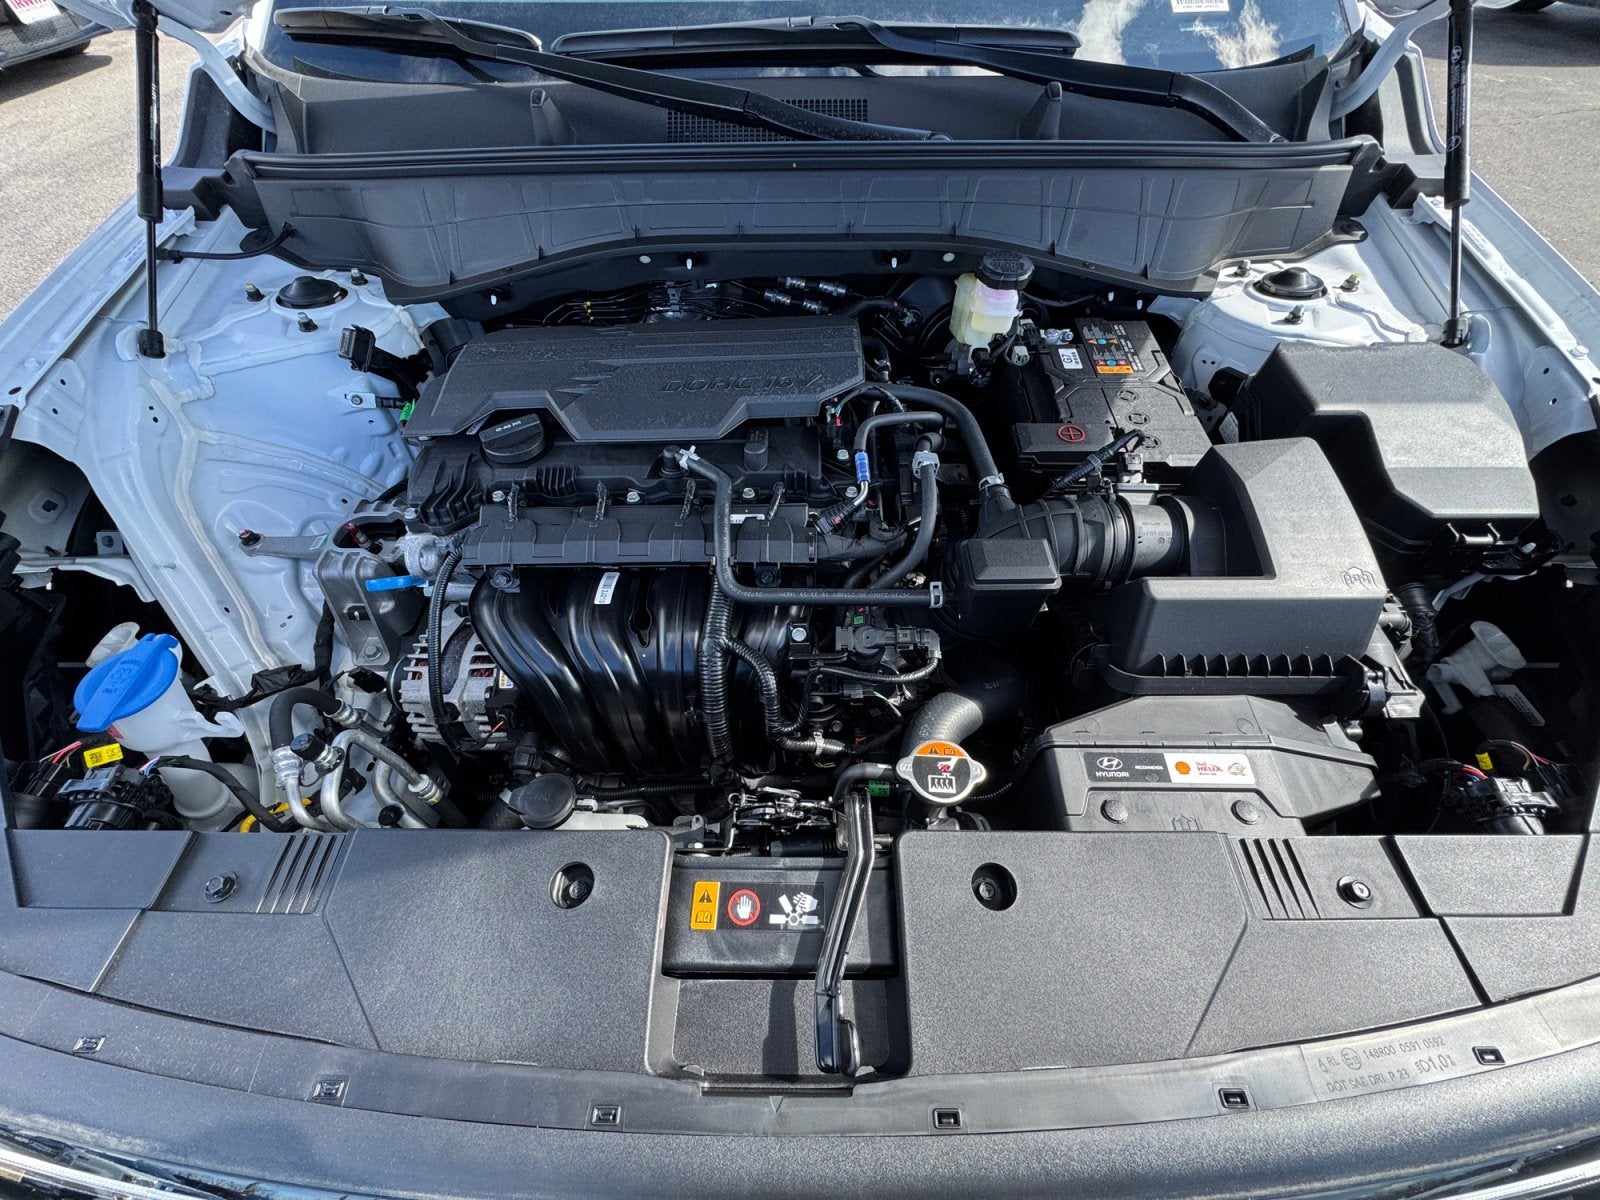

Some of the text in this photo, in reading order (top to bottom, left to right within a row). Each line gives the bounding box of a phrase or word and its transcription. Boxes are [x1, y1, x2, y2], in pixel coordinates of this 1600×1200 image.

[1062, 354, 1073, 364] G7
[660, 377, 755, 392] DOHC
[1399, 1042, 1421, 1053] 0591
[1422, 1036, 1446, 1049] 0592
[1326, 1081, 1347, 1093] DOT
[1350, 1077, 1367, 1089] SAE
